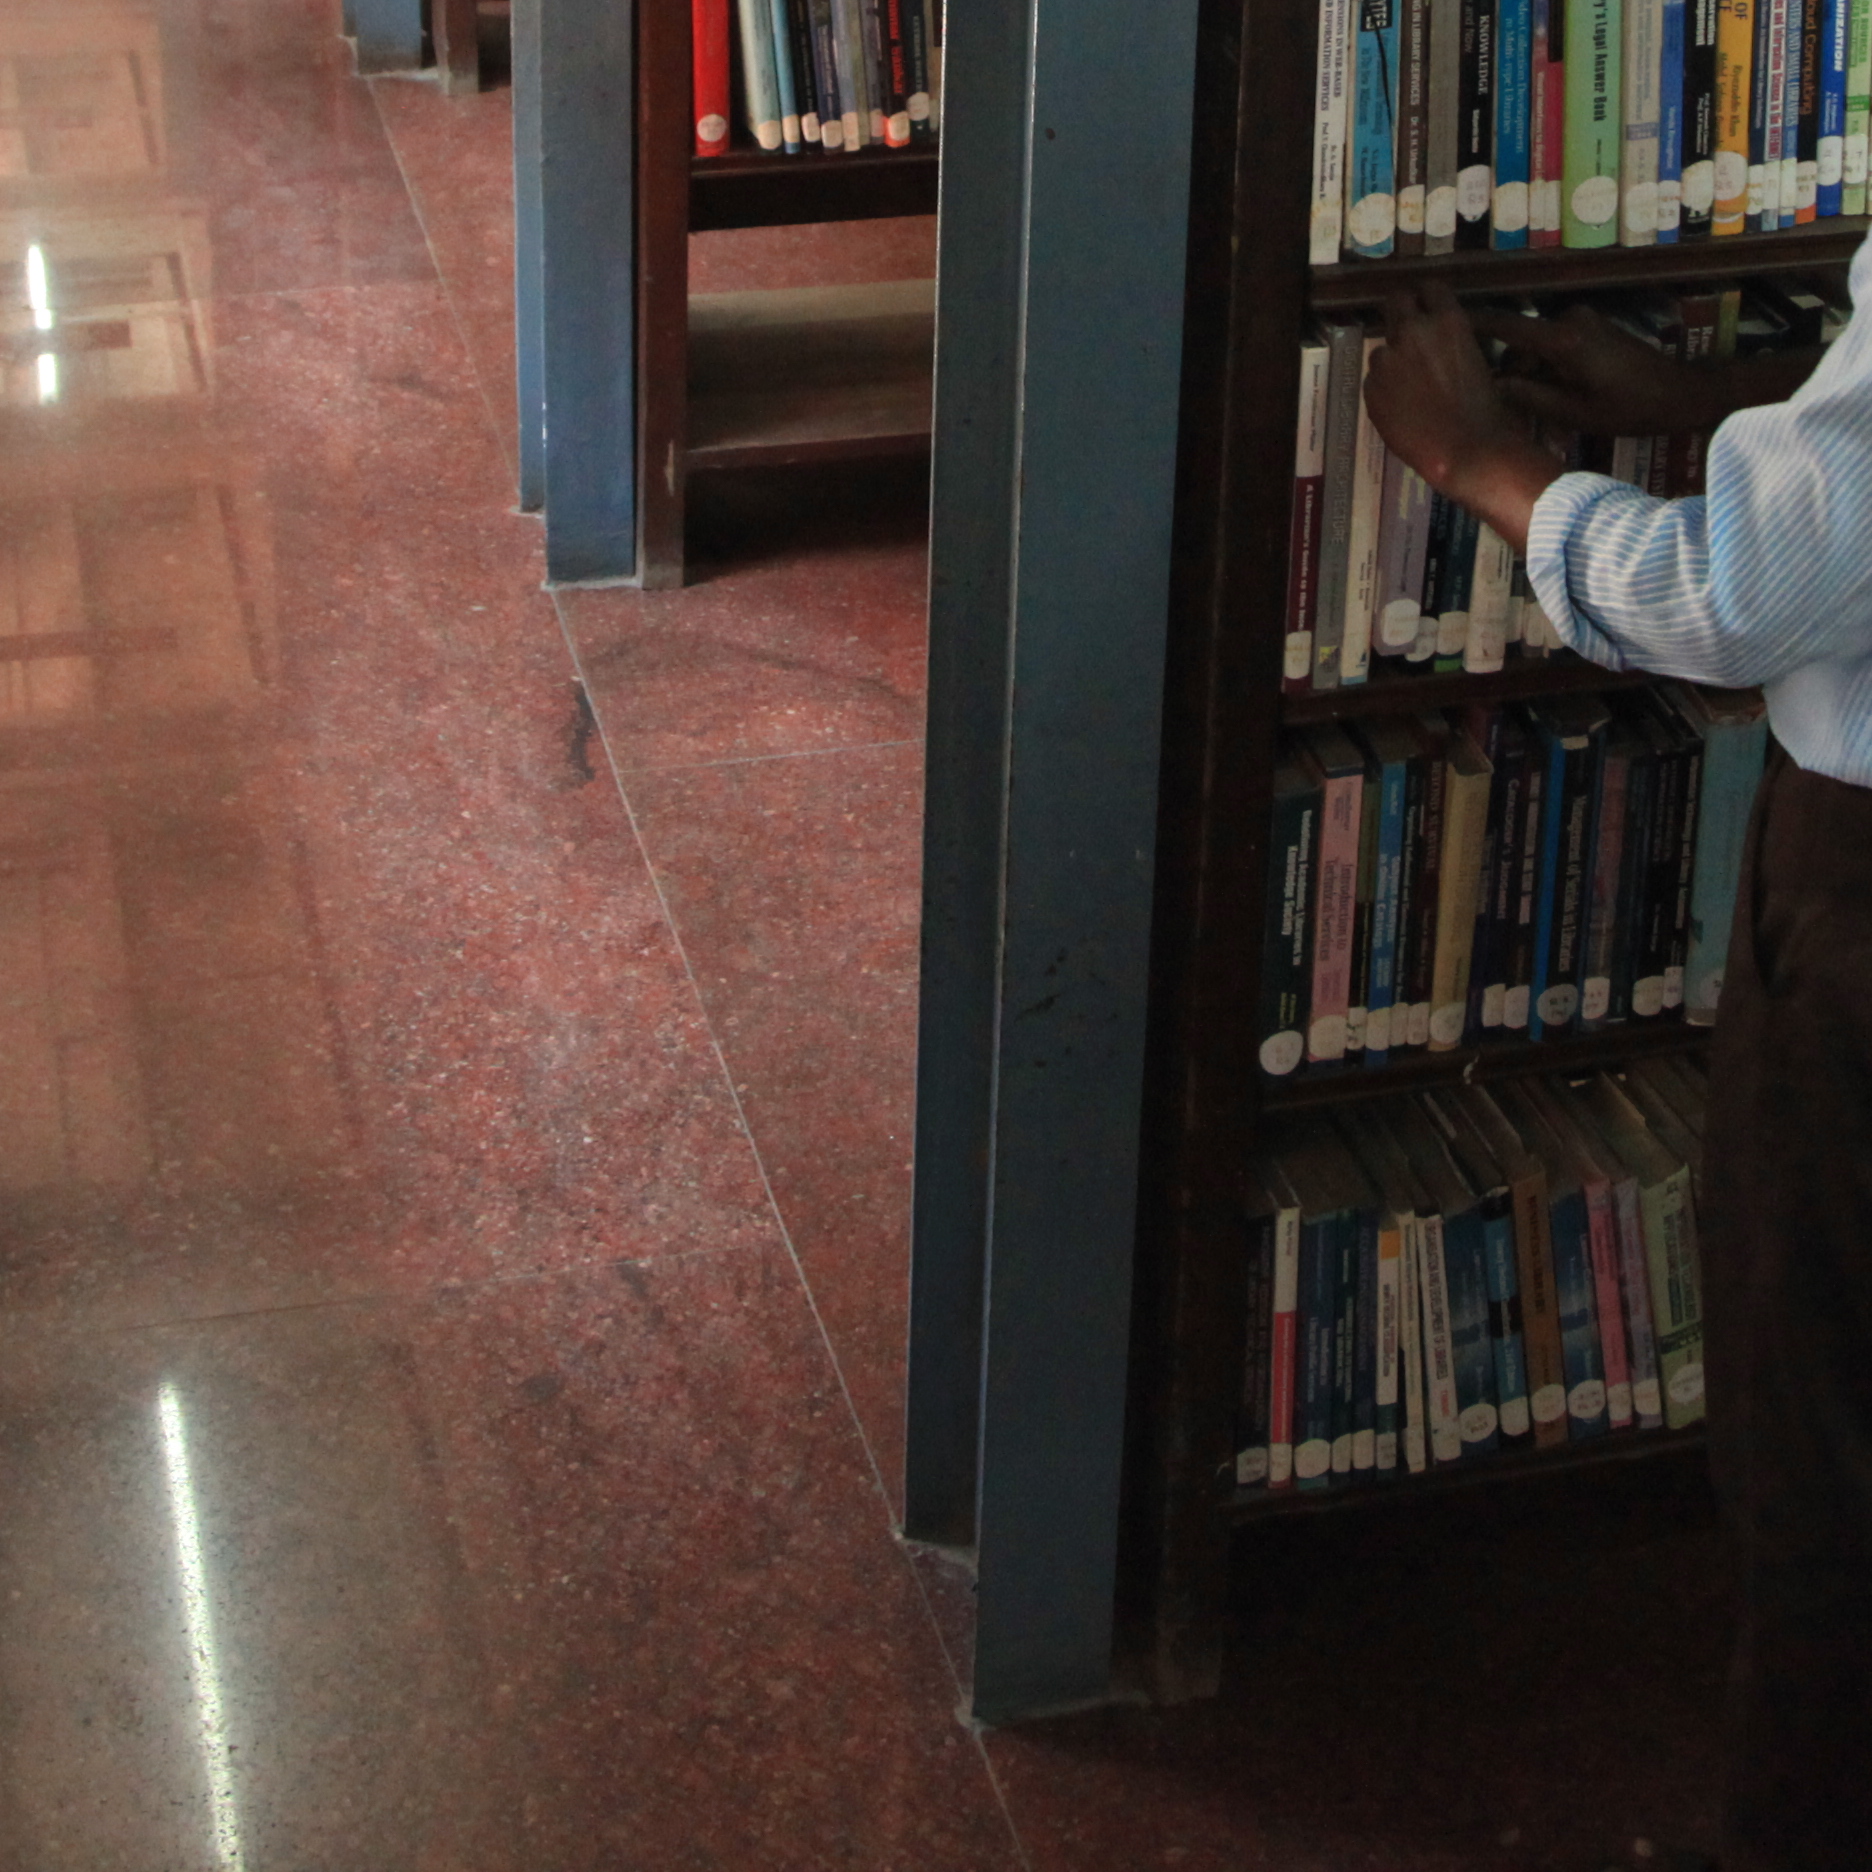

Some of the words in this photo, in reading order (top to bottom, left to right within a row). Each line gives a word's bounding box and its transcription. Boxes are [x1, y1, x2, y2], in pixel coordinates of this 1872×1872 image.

[1735, 3, 1748, 20] OF
[1591, 23, 1607, 50] Legal
[1594, 54, 1607, 92] Answer
[1593, 97, 1606, 121] Book
